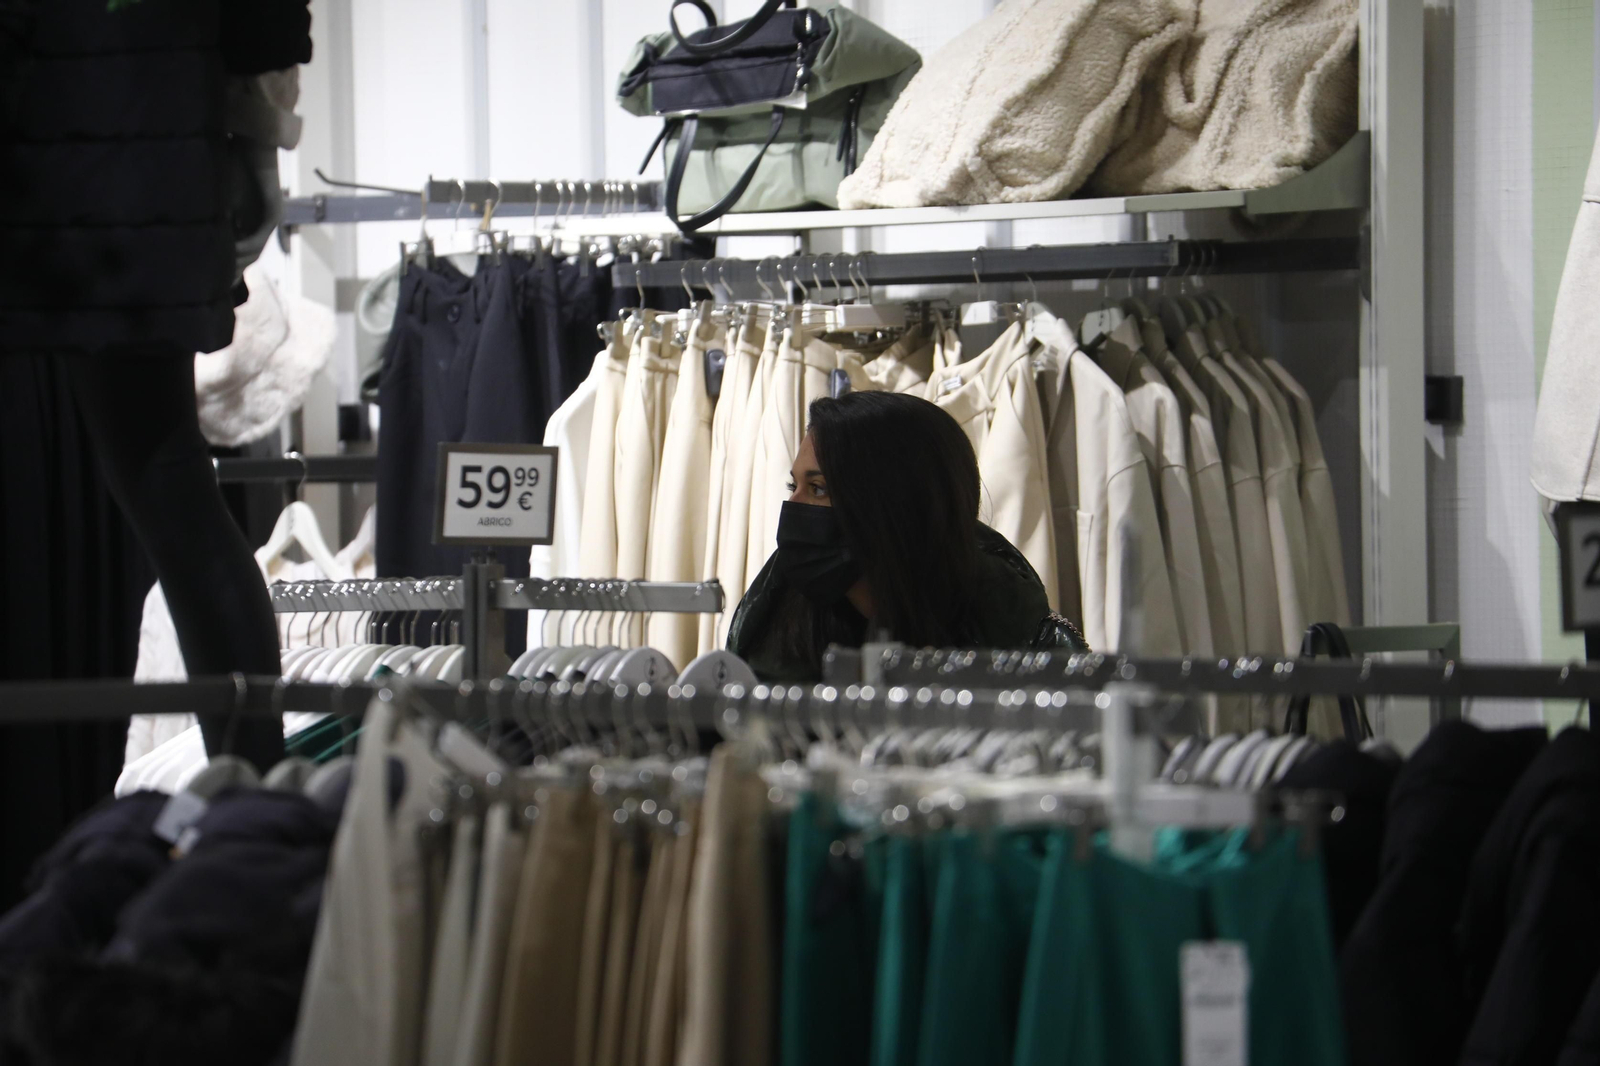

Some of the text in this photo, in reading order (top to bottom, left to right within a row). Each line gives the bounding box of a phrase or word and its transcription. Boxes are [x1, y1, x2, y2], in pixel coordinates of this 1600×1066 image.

[456, 465, 540, 511] 59 99 €
